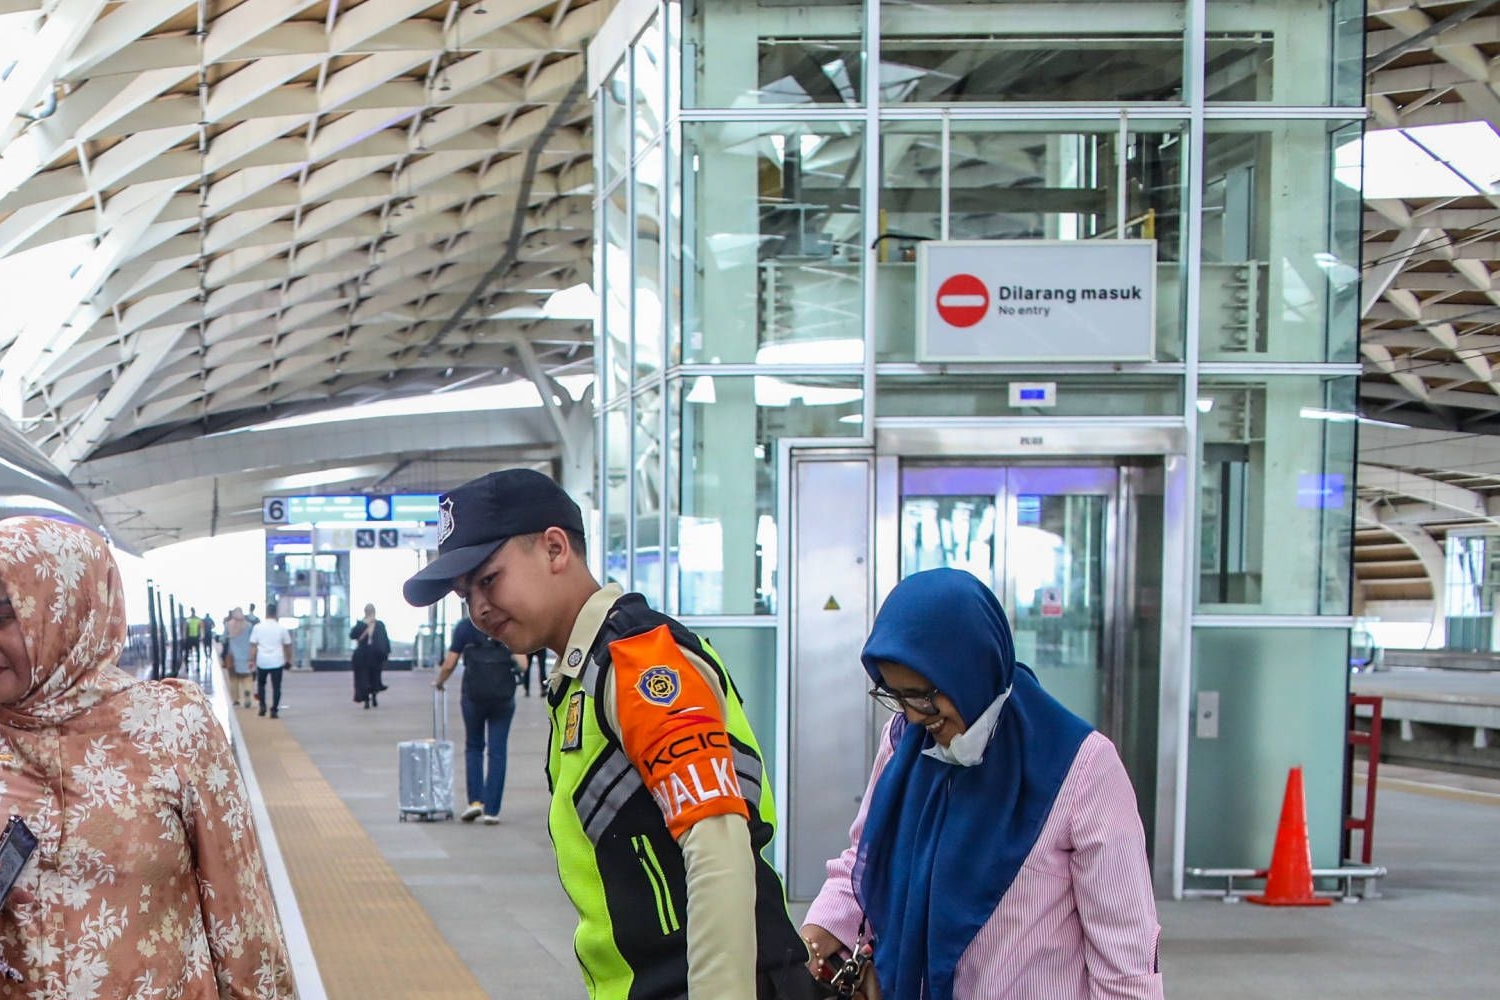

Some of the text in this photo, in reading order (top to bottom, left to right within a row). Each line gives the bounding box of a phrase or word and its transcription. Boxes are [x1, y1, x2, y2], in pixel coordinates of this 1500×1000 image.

[999, 286, 1142, 303] Dilarang masuk
[999, 305, 1050, 318] No entry
[268, 500, 284, 520] 6
[643, 731, 727, 776] KCIC
